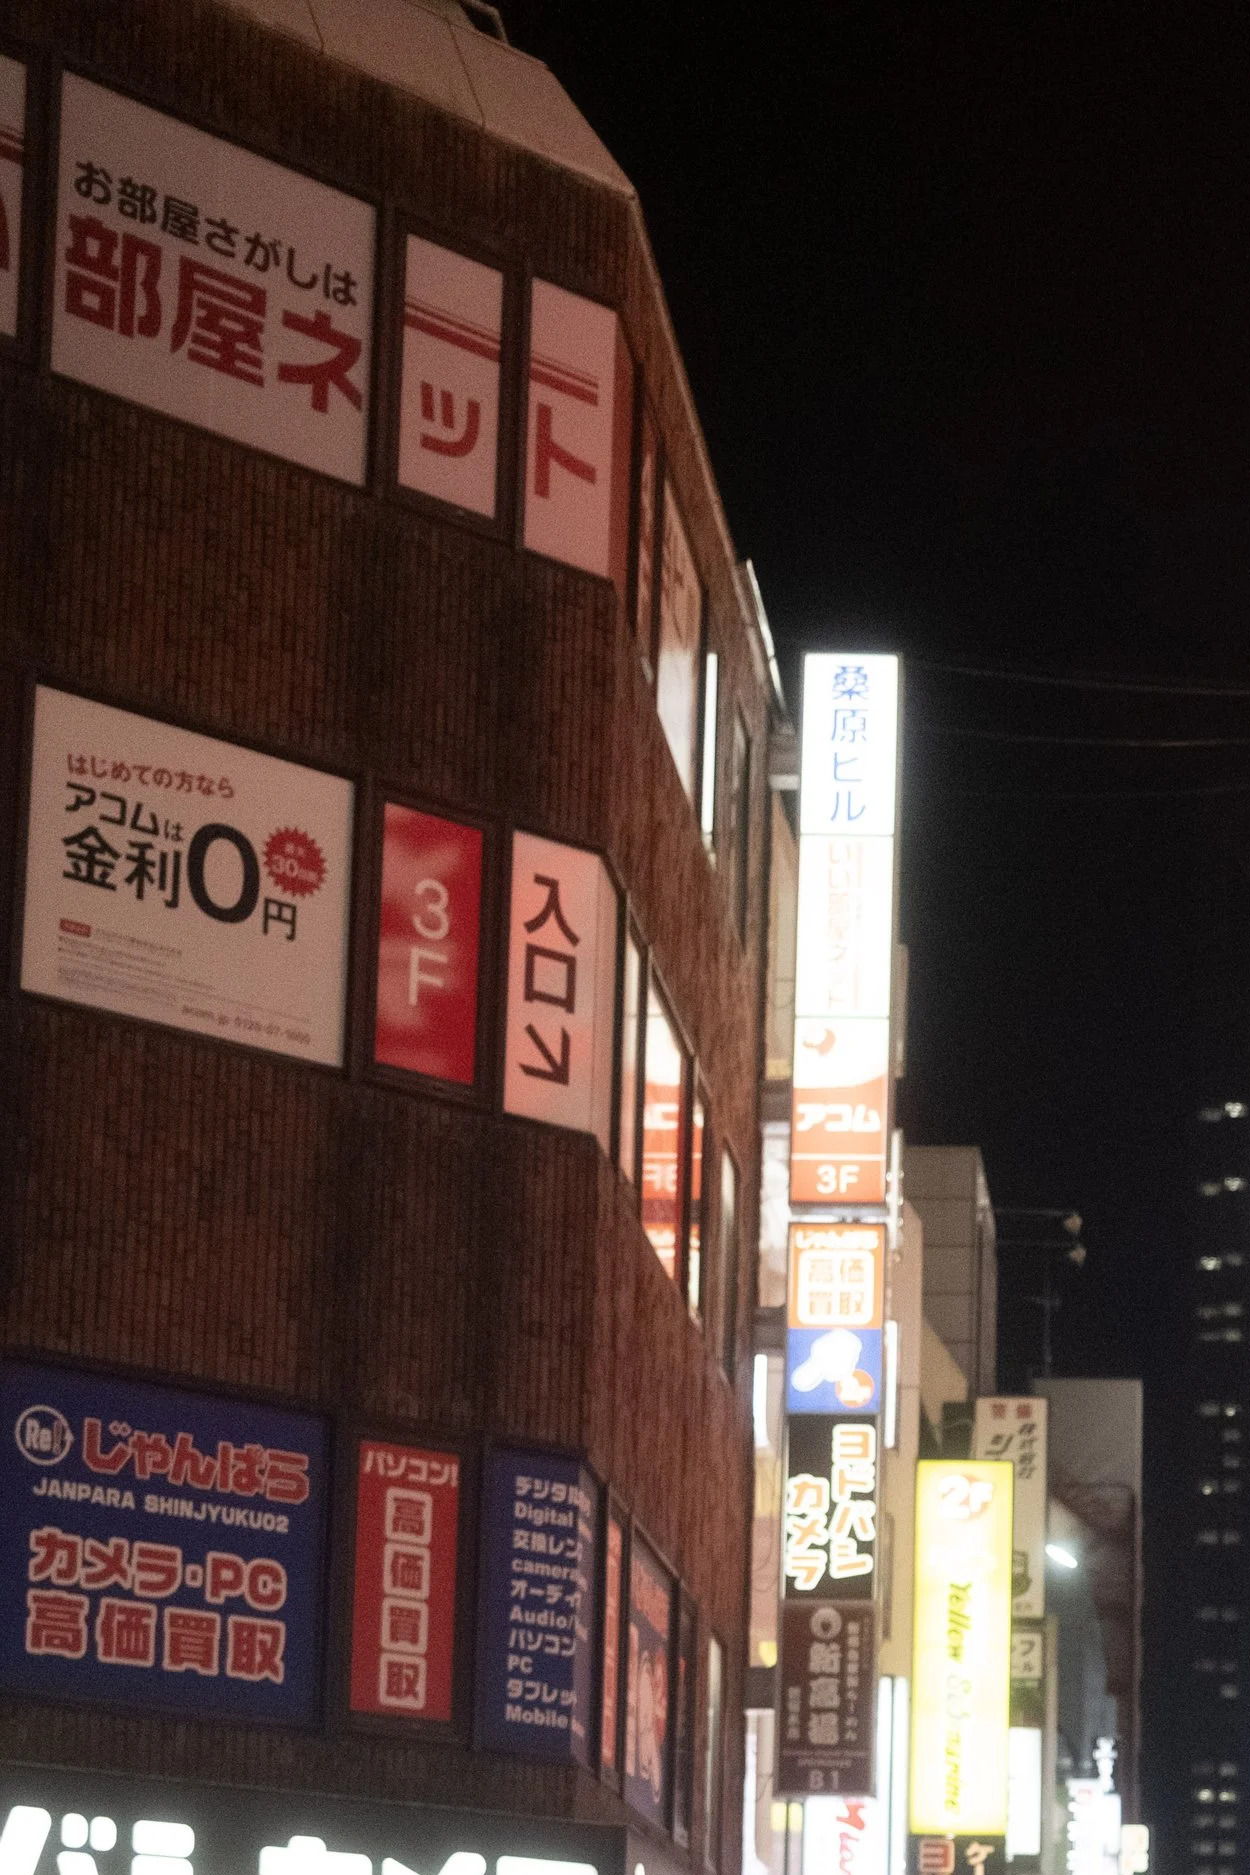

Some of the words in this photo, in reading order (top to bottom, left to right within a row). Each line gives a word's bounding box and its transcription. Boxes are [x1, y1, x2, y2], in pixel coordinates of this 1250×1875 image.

[73, 160, 358, 307] お部屋さがしは
[66, 753, 235, 799] はじめての方なら
[64, 782, 185, 842] アコムは
[62, 822, 299, 942] 金利0円
[408, 879, 450, 1006] 3F
[522, 874, 580, 1014] 入口
[797, 1104, 881, 1132] アコム
[816, 1164, 860, 1193] 3F
[82, 1416, 310, 1506] じゃんぱら
[33, 1477, 136, 1510] JANPARA
[143, 1494, 289, 1534] SHINJYUKU02
[938, 1474, 995, 1521] 2F
[785, 1474, 830, 1592] カメラ
[379, 1486, 433, 1710] 高価買取
[26, 1587, 287, 1685] 高価買取
[507, 1654, 533, 1675] PC
[508, 1627, 577, 1657] パソコン
[504, 1702, 569, 1729] Mobile
